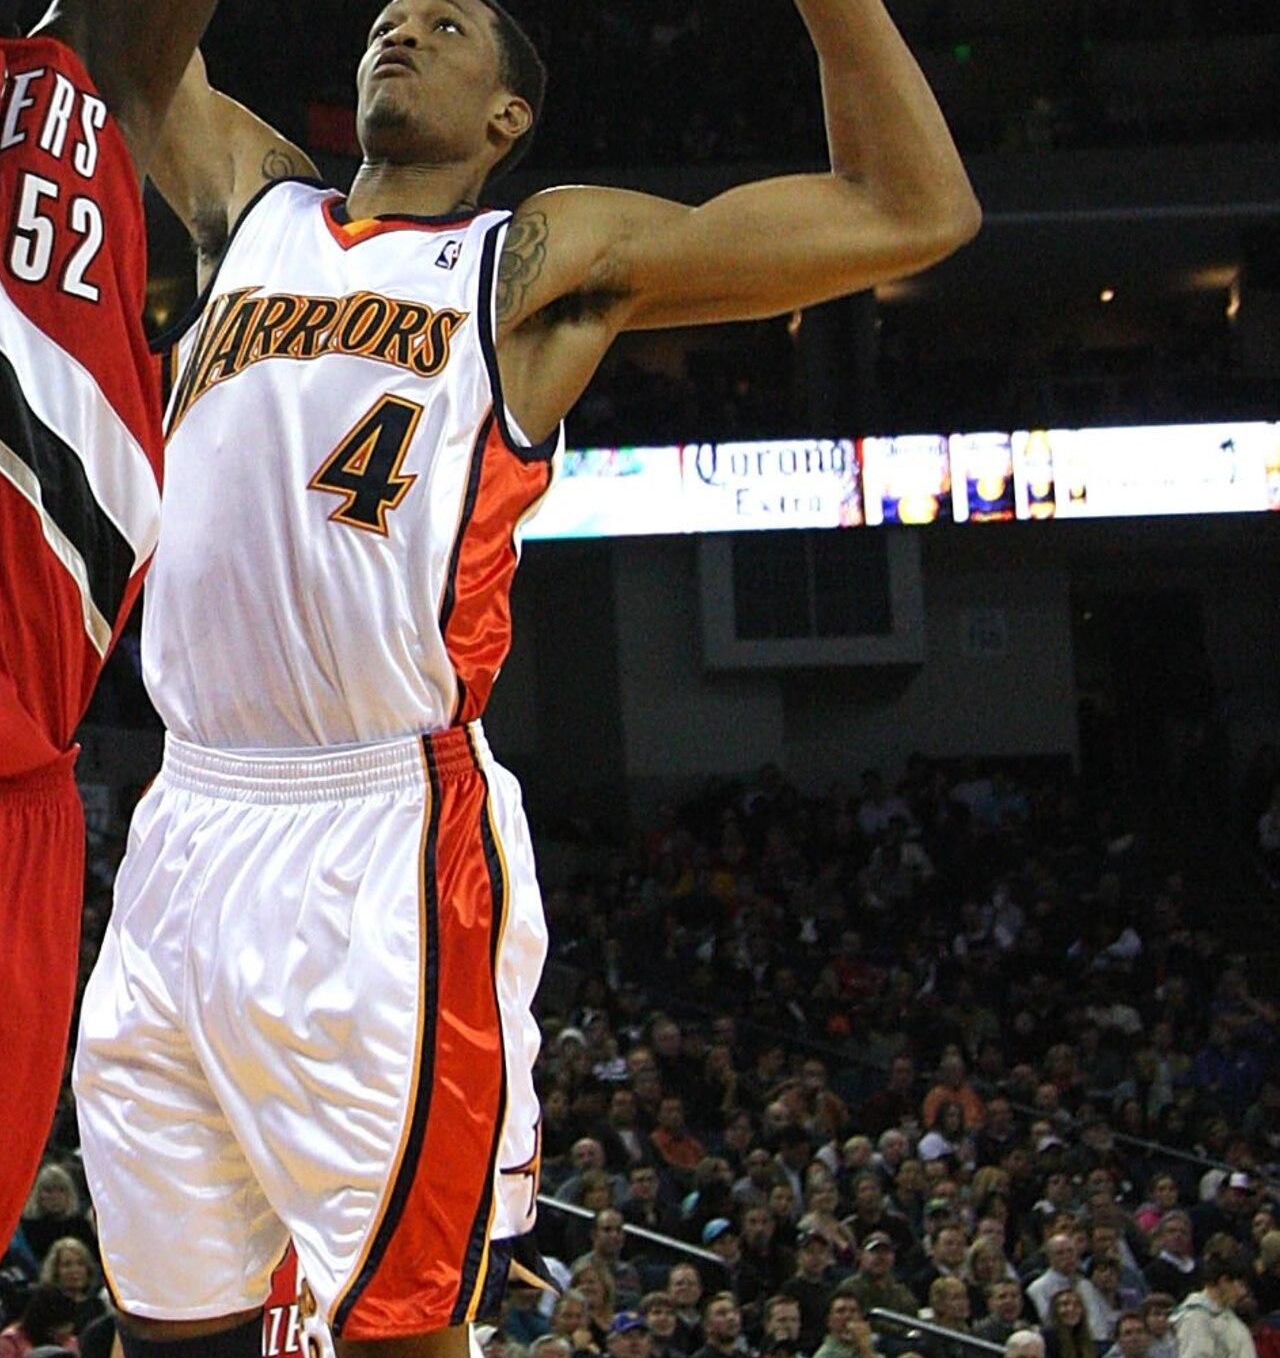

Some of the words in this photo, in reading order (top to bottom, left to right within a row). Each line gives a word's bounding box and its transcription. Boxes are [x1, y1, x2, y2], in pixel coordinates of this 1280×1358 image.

[9, 171, 105, 303] 52
[308, 392, 424, 538] 4
[695, 442, 846, 487] Corona
